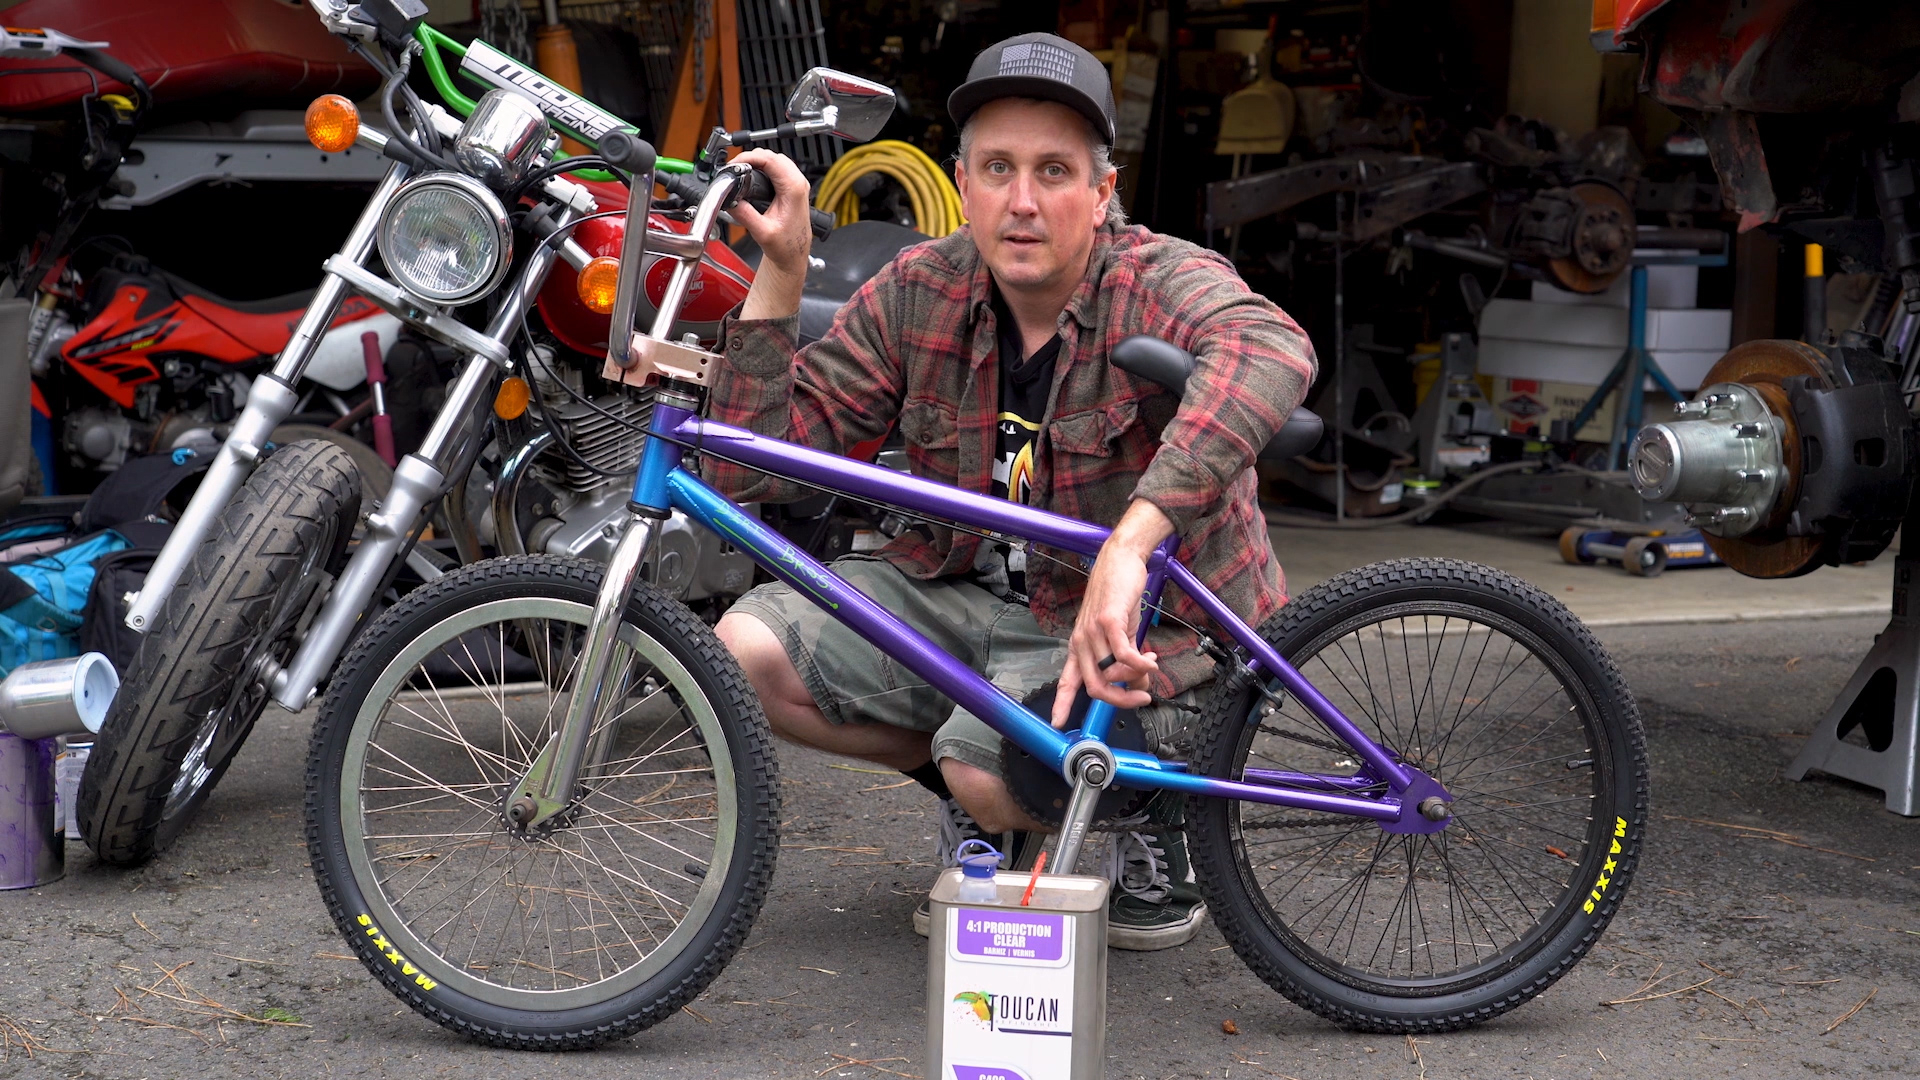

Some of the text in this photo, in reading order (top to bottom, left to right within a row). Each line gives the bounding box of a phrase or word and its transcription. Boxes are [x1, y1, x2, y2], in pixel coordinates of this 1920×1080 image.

[495, 64, 627, 131] MOOSE
[536, 102, 605, 141] RACING
[1583, 816, 1628, 915] MAXXIS
[966, 920, 1052, 938] 4:1 PRODUCTION
[993, 935, 1026, 948] CLEAR
[357, 914, 438, 991] MAXXIS
[983, 947, 1036, 958] BARNIZ VERNIS
[988, 994, 1059, 1031] TOUCAN
